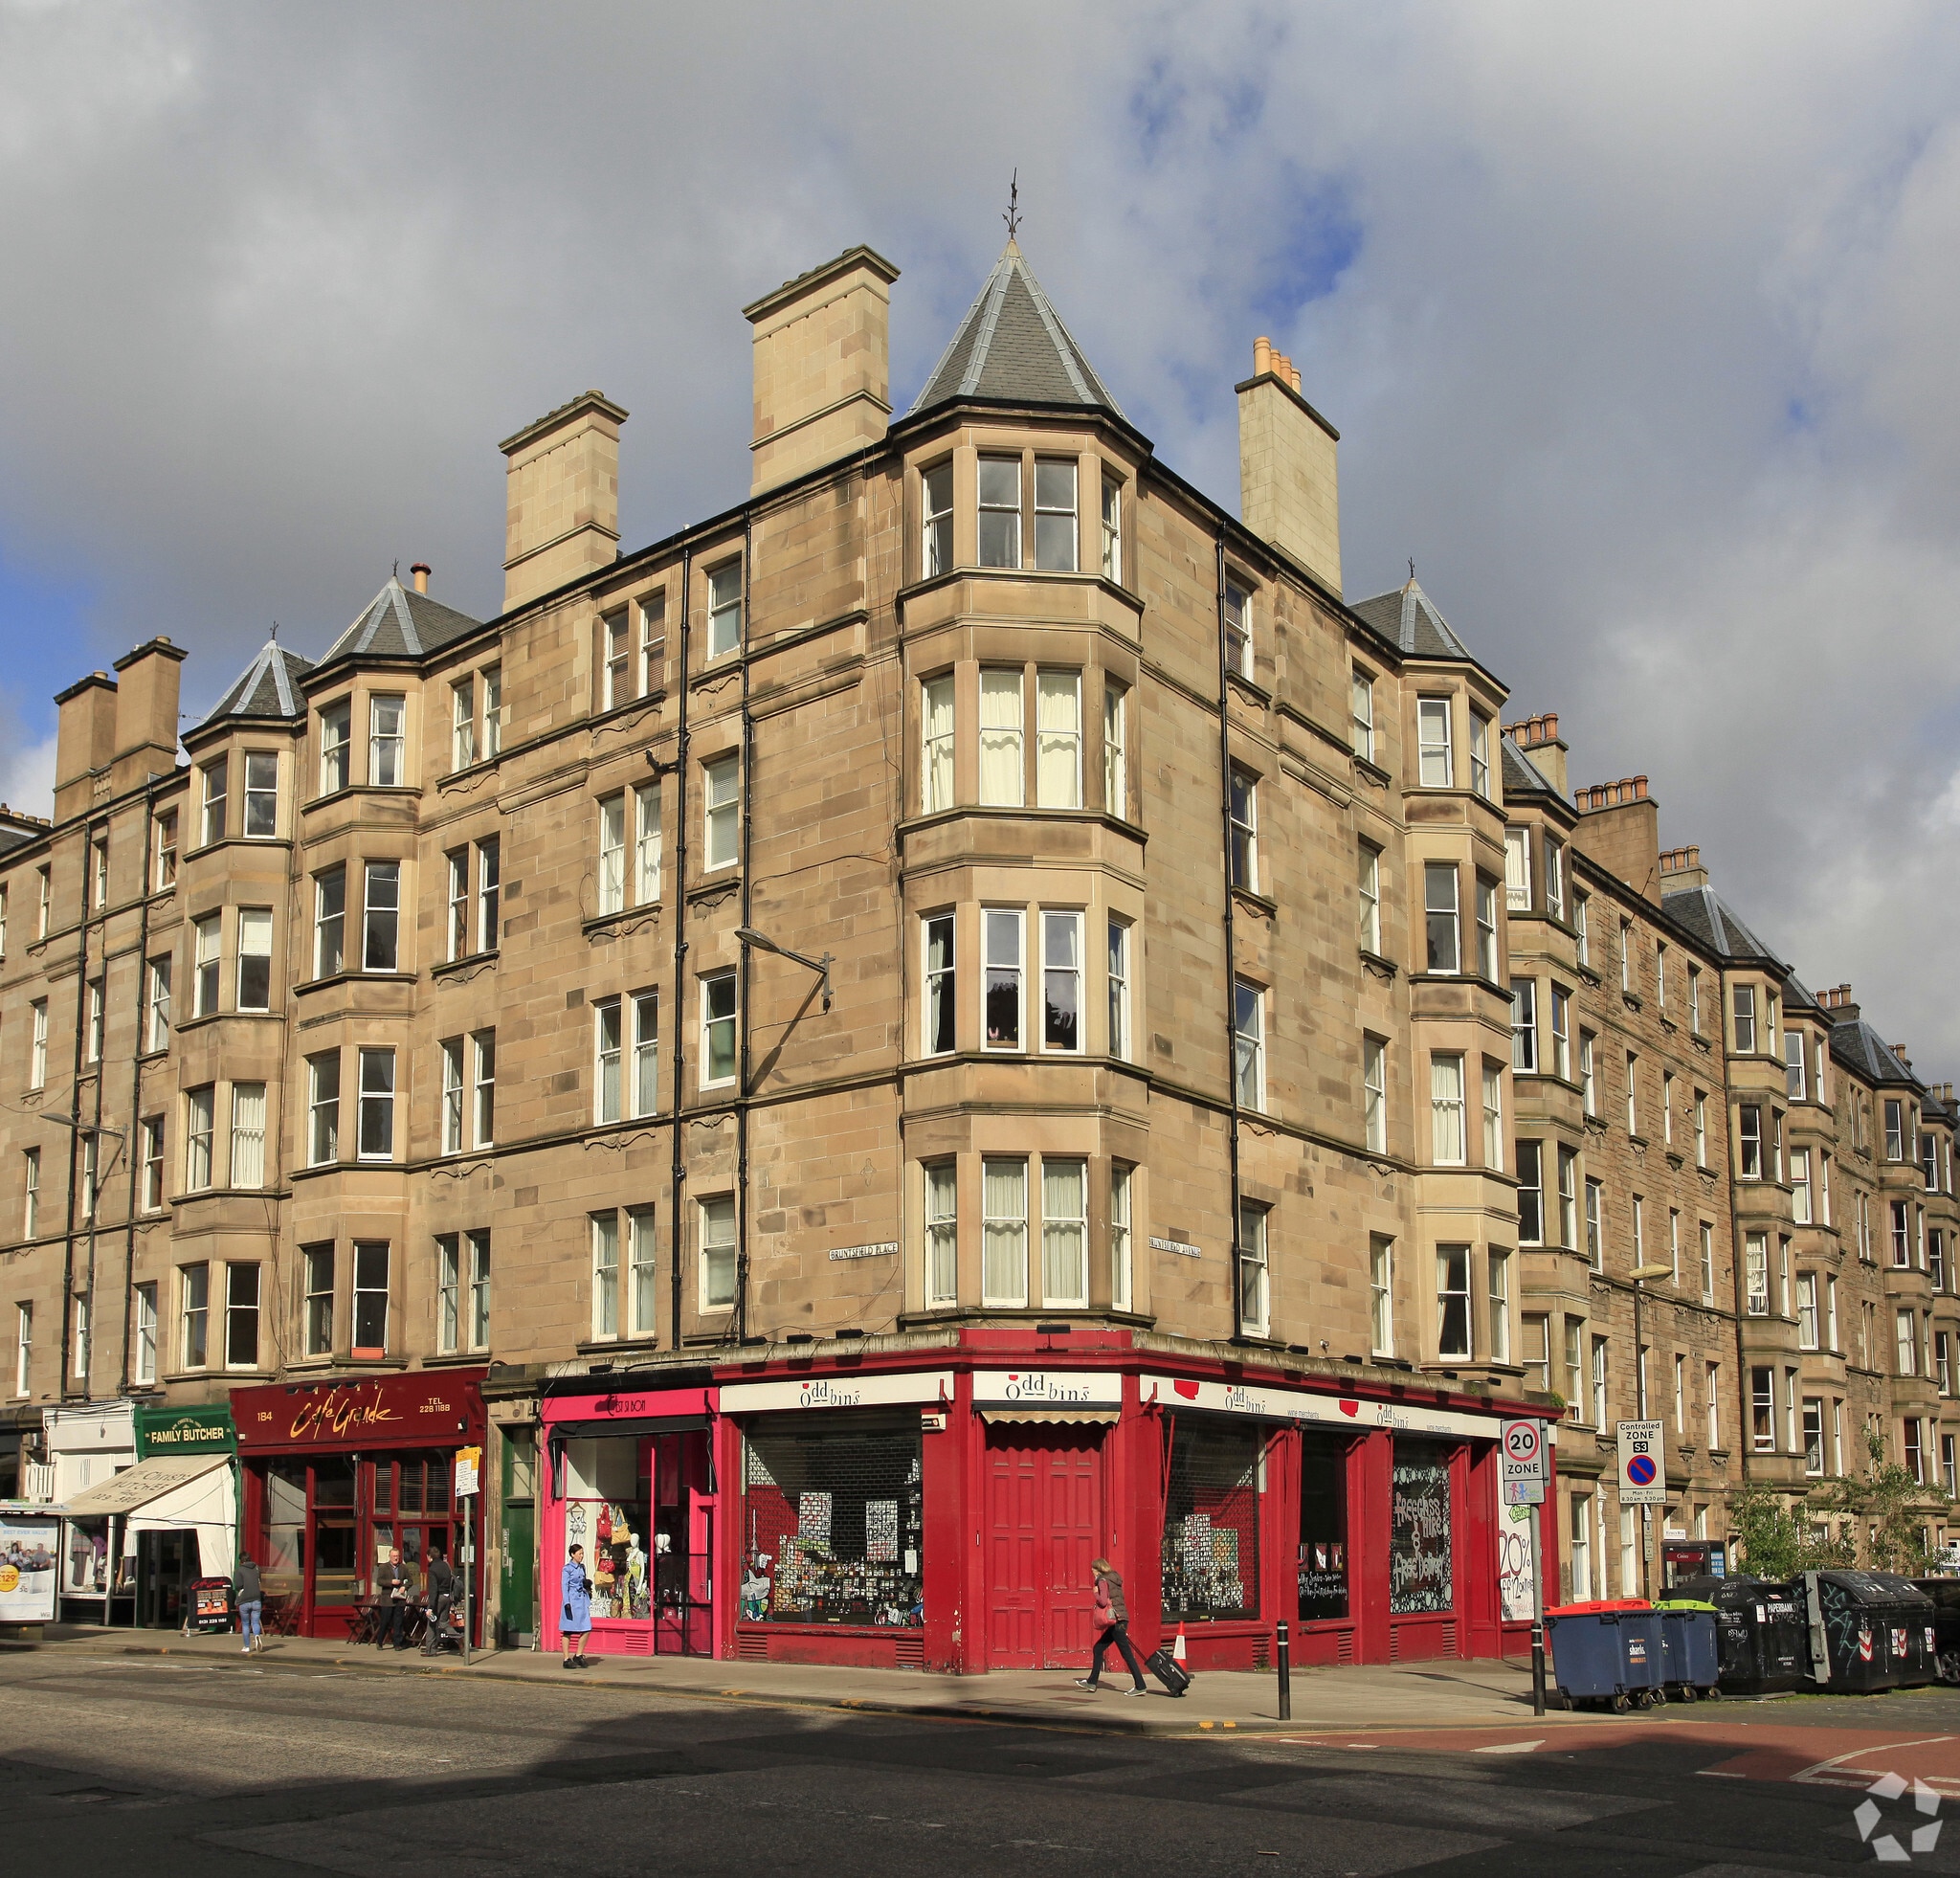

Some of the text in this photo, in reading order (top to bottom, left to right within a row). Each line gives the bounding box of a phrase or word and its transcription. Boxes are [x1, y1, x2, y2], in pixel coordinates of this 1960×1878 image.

[831, 1243, 897, 1259] BRUNTSFIELD PLACE
[1182, 1245, 1200, 1257] AVENUE
[800, 1381, 860, 1408] Oddbins
[1005, 1375, 1090, 1400] Oddbins
[1225, 1386, 1266, 1414] Oddbins
[257, 1412, 273, 1421] 184
[332, 1388, 404, 1438] Grande
[1298, 1410, 1320, 1420] merchants
[1376, 1404, 1409, 1429] Oddbins
[1619, 1422, 1660, 1431] Controlled
[151, 1427, 224, 1443] FAMILY BUTCHER
[1510, 1434, 1534, 1450] 20
[1626, 1431, 1655, 1440] ZONE
[1634, 1442, 1648, 1452] S3
[1507, 1464, 1539, 1474] ZONE
[1767, 1602, 1793, 1613] PAPERBANK
